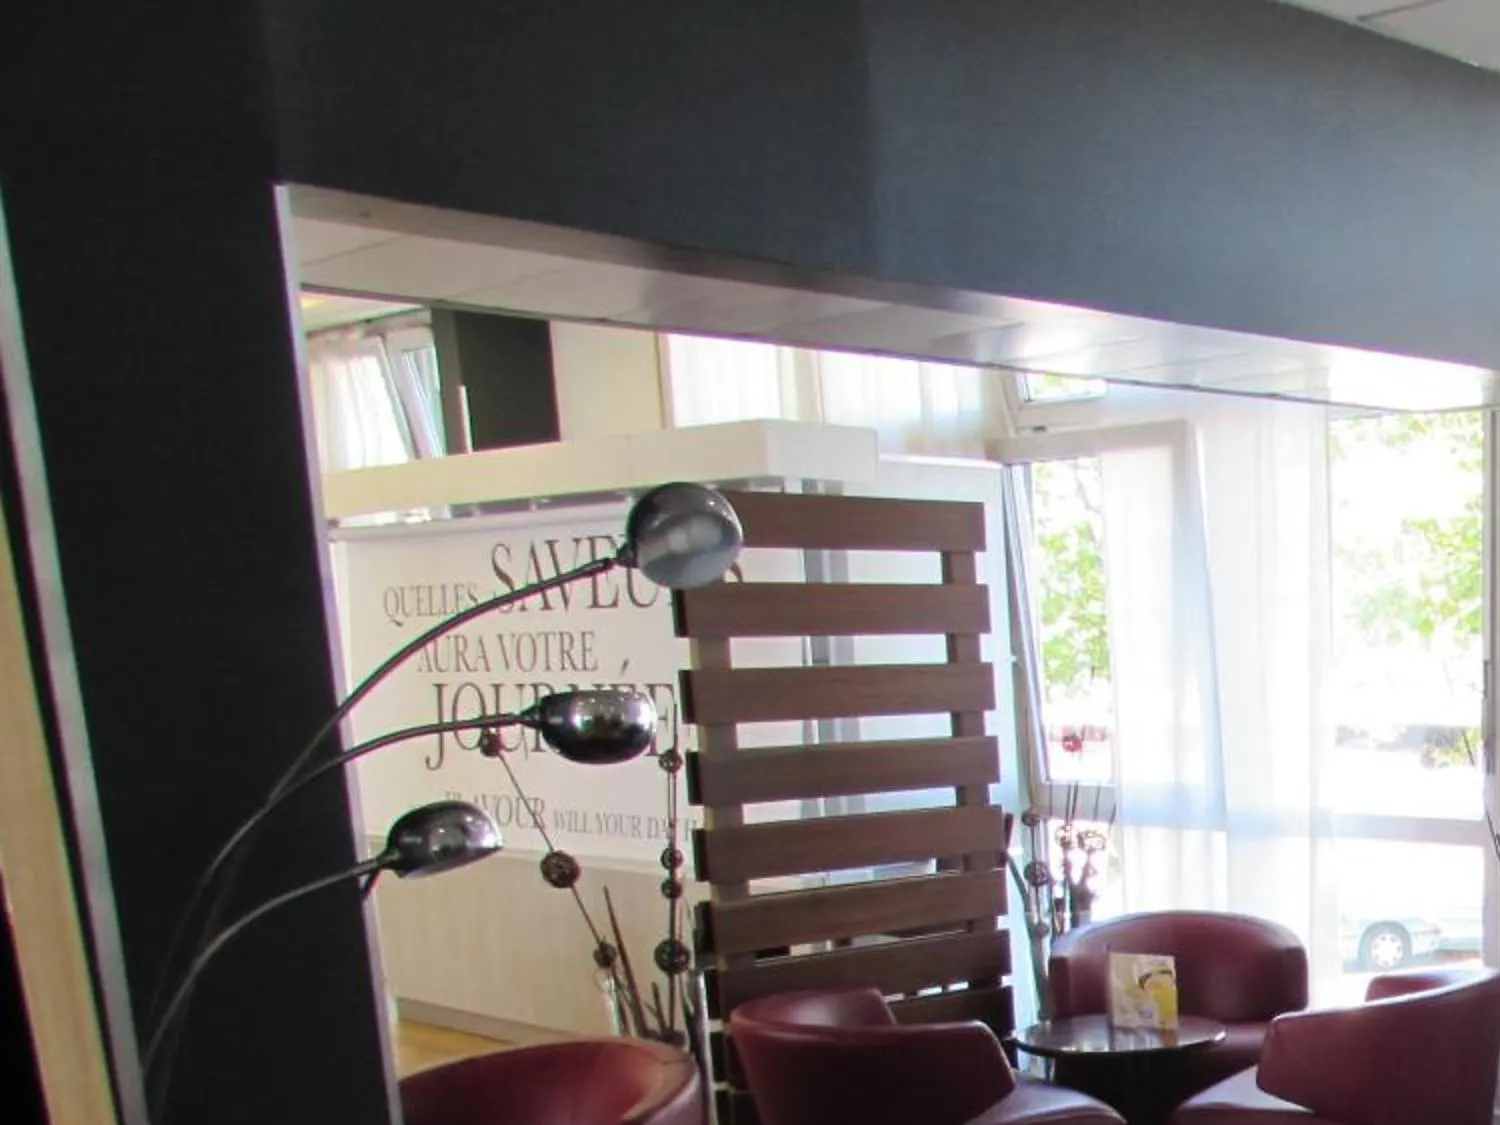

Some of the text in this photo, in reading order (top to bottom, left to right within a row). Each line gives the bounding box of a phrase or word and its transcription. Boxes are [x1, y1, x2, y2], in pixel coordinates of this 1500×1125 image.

[383, 535, 743, 627] QUELLES SAVEU
[417, 631, 598, 673] AURA VOTRE
[553, 809, 592, 833] WILL
[596, 812, 643, 838] YOUR
